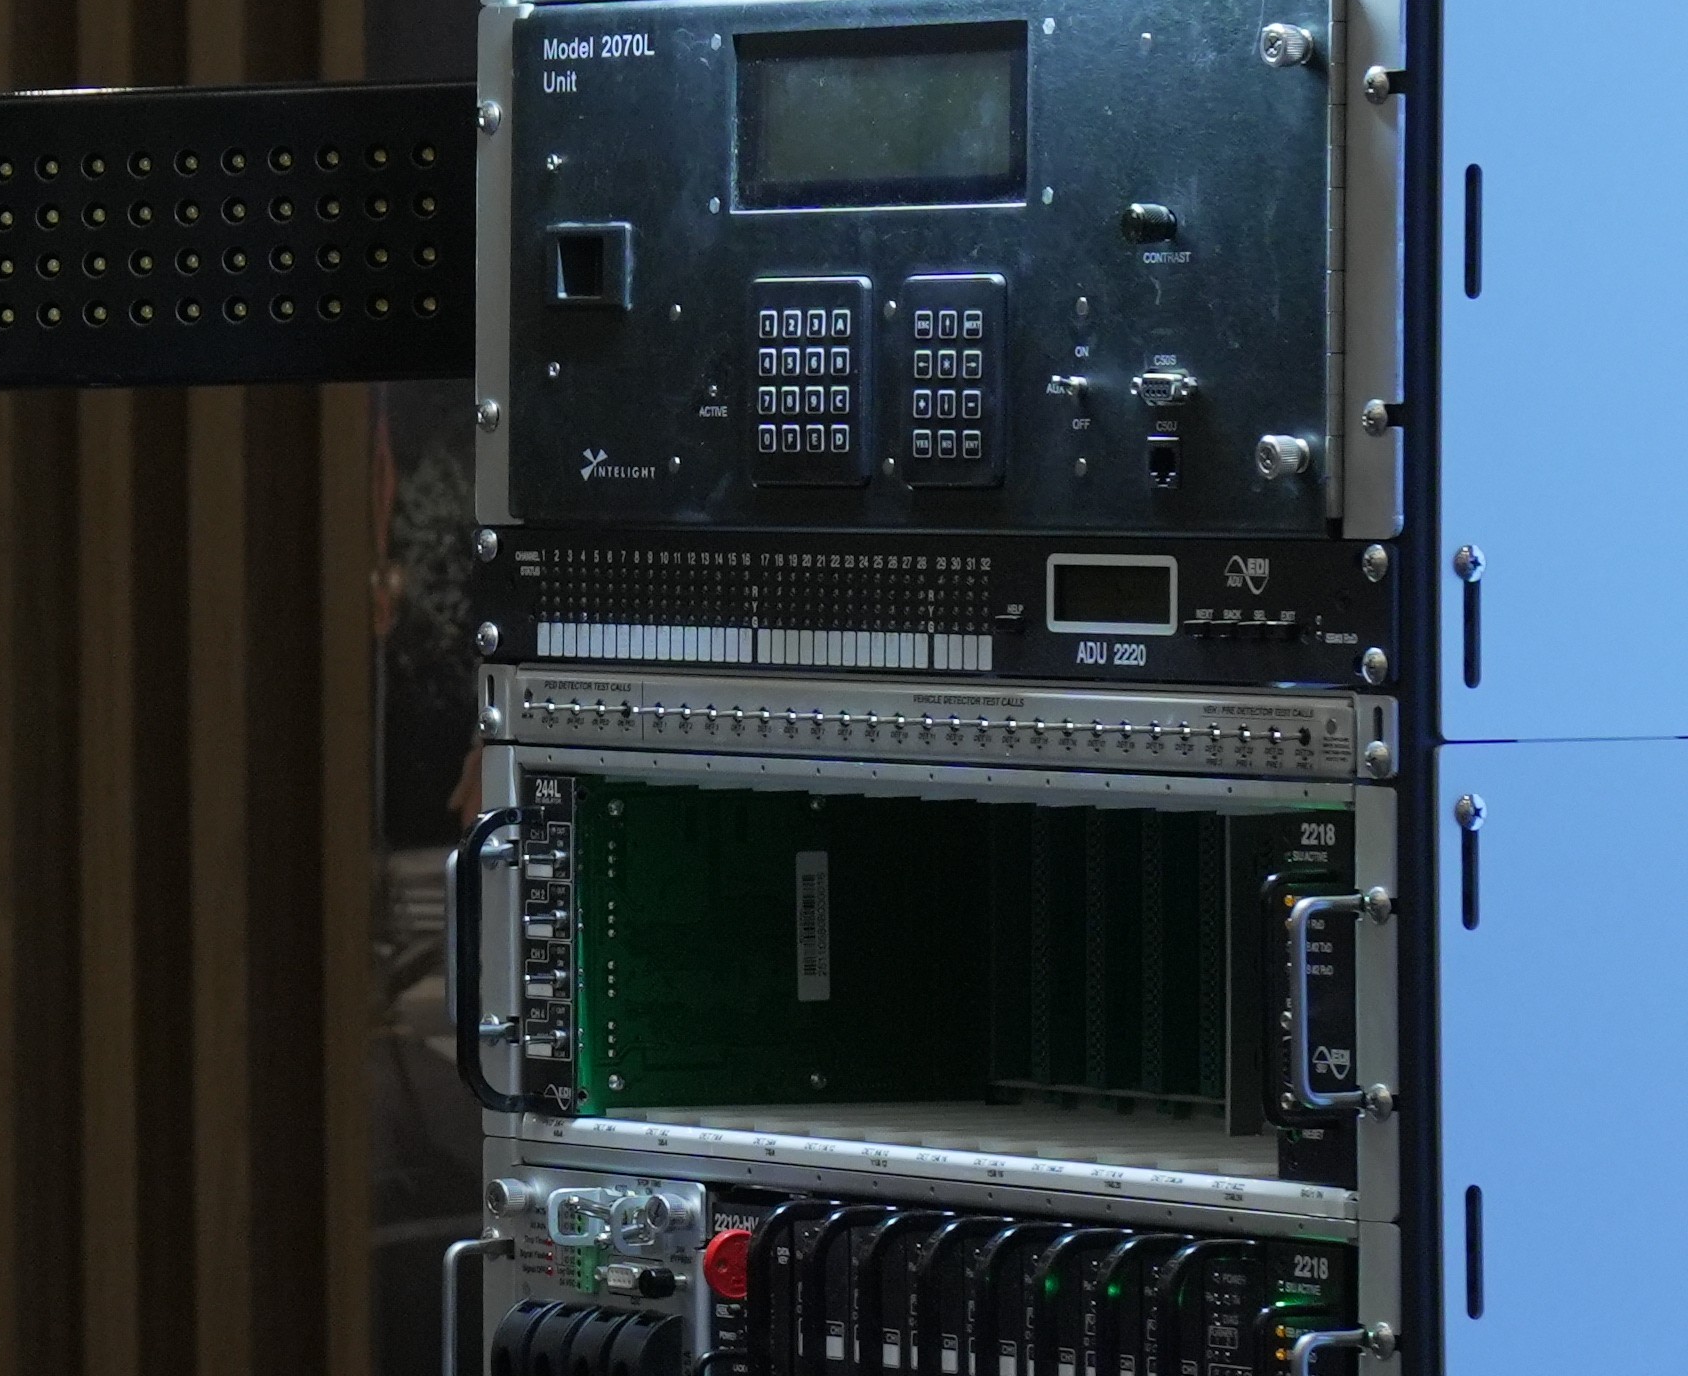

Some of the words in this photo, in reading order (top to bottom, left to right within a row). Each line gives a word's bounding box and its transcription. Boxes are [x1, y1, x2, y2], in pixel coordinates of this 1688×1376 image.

[544, 36, 594, 60] Model
[601, 33, 655, 58] 2070L
[544, 70, 577, 93] Unit
[1143, 251, 1191, 264] CONTRAST
[1074, 346, 1089, 358] ON
[699, 406, 728, 417] ACTIVE
[1072, 419, 1091, 430] OFF
[593, 465, 656, 479] INTELIGHT
[936, 557, 946, 570] 29
[951, 557, 961, 570] 30
[966, 558, 976, 570] 31
[981, 558, 991, 570] 32
[1247, 558, 1269, 576] EDI
[1227, 576, 1244, 588] ADU
[1196, 609, 1214, 619] NEXT
[1224, 609, 1242, 619] BACK
[1076, 641, 1107, 665] ADU
[1113, 643, 1146, 666] 2220
[558, 681, 592, 692] DETECTOR
[593, 682, 611, 692] TEST
[612, 683, 631, 693] CALLS
[939, 696, 981, 706] DETECTOR
[982, 697, 1001, 707] TEST
[1002, 698, 1024, 708] CALLS
[535, 778, 561, 798] 244L
[1300, 823, 1336, 846] 2218
[1294, 1254, 1329, 1279] 2218
